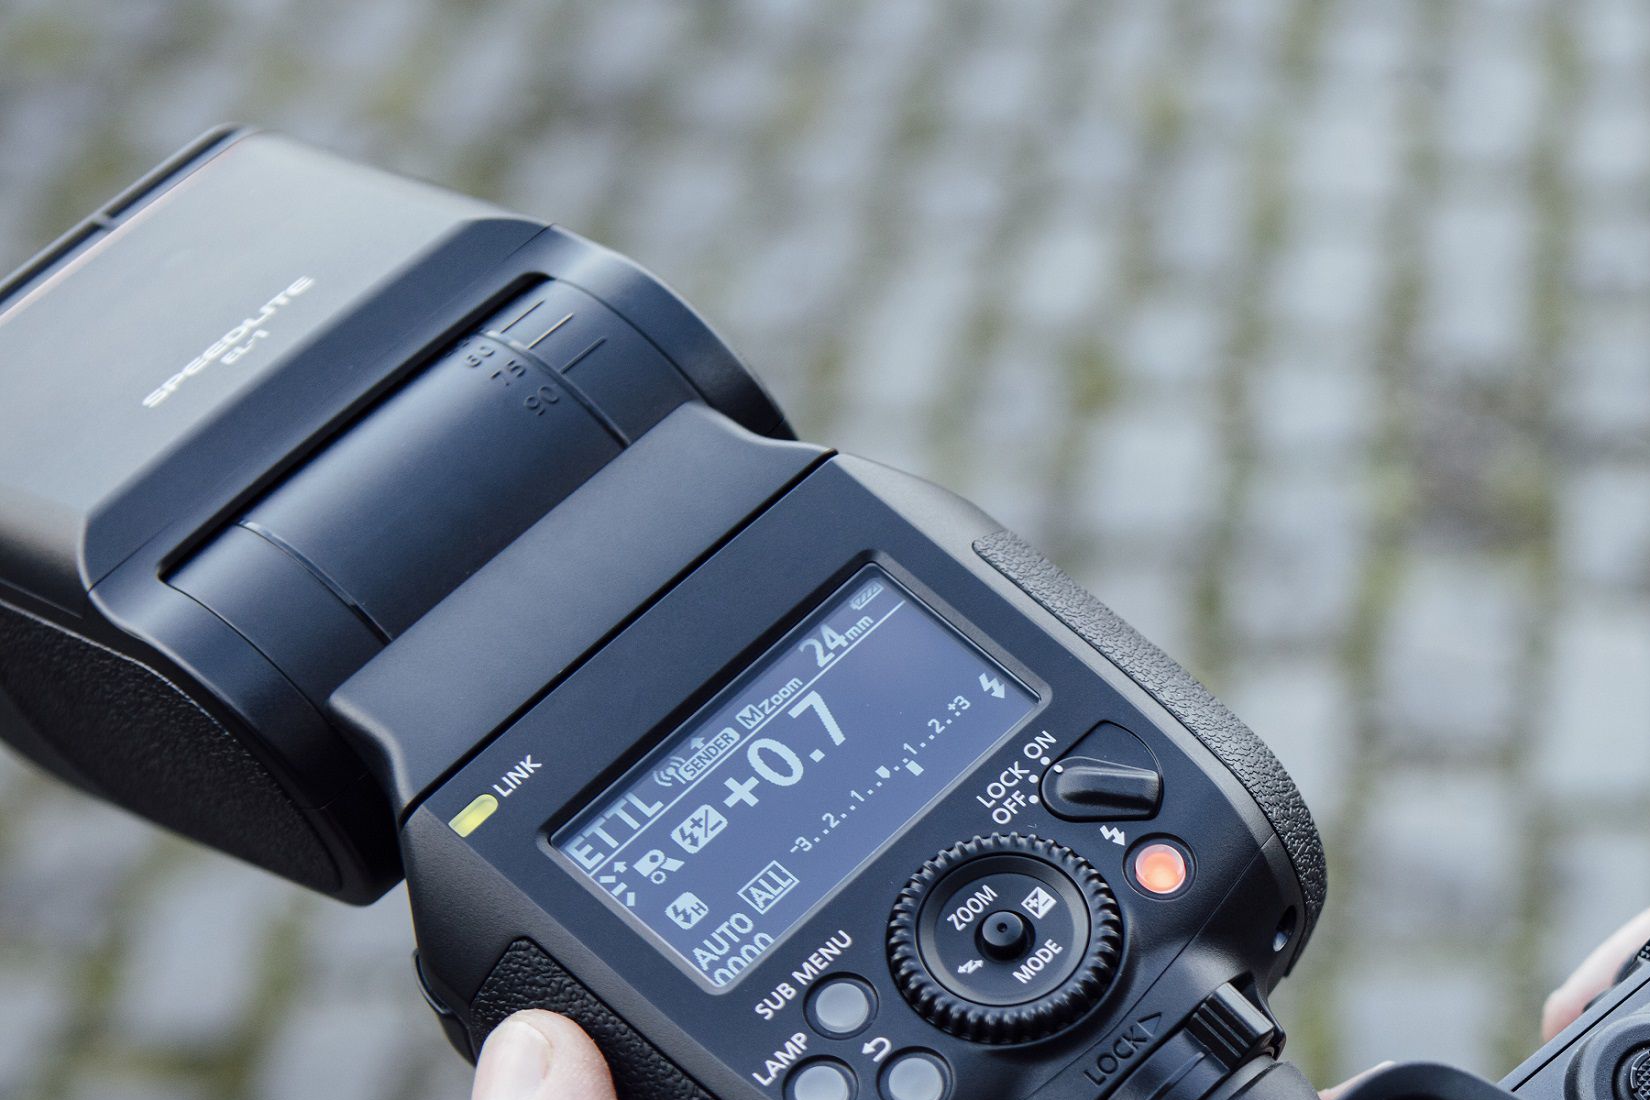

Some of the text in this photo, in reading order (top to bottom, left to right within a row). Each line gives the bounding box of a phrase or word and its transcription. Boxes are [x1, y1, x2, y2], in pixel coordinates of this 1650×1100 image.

[142, 275, 315, 408] SPEEDLITE
[492, 754, 543, 797] LINK
[722, 690, 847, 808] +0.7
[976, 731, 1057, 808] LOCK ON
[567, 793, 664, 870] ETTL
[683, 731, 735, 780] SENDER
[992, 790, 1027, 825] OFF
[749, 870, 793, 909] ALL
[946, 884, 998, 932] ZOOM
[692, 912, 754, 971] AUTO
[1012, 938, 1063, 985] MODE
[755, 930, 853, 1020] SUB MENU
[752, 1032, 809, 1087] LAMP
[1083, 1025, 1148, 1087] LOCK
